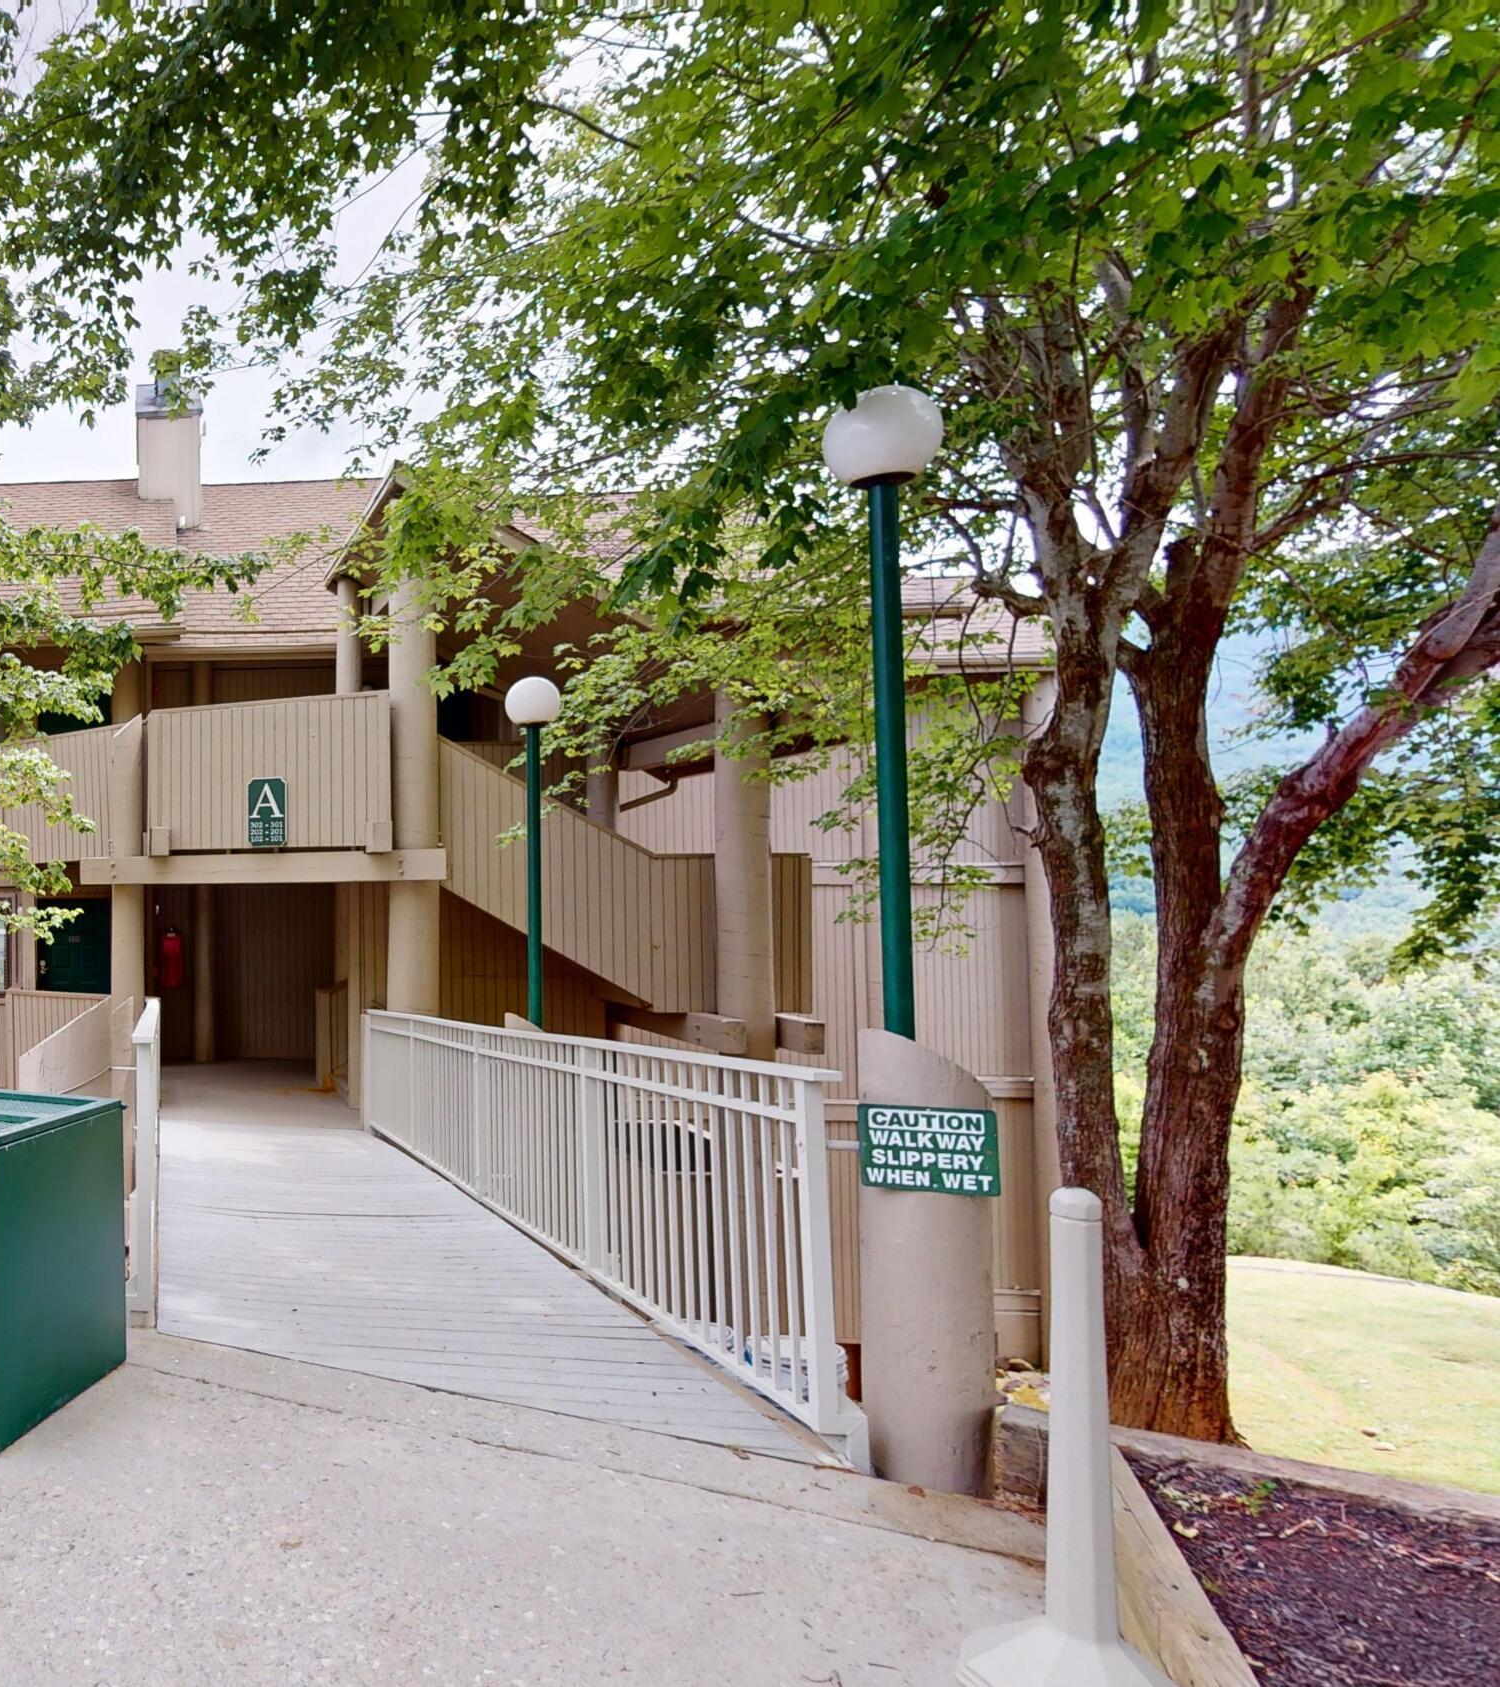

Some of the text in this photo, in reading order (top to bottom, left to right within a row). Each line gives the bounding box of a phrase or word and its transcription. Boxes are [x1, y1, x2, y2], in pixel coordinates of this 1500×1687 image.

[249, 782, 284, 818] A
[871, 1111, 982, 1131] CAUTION
[871, 1149, 984, 1171] SLIPPERY
[866, 1167, 993, 1191] WHEN WET
